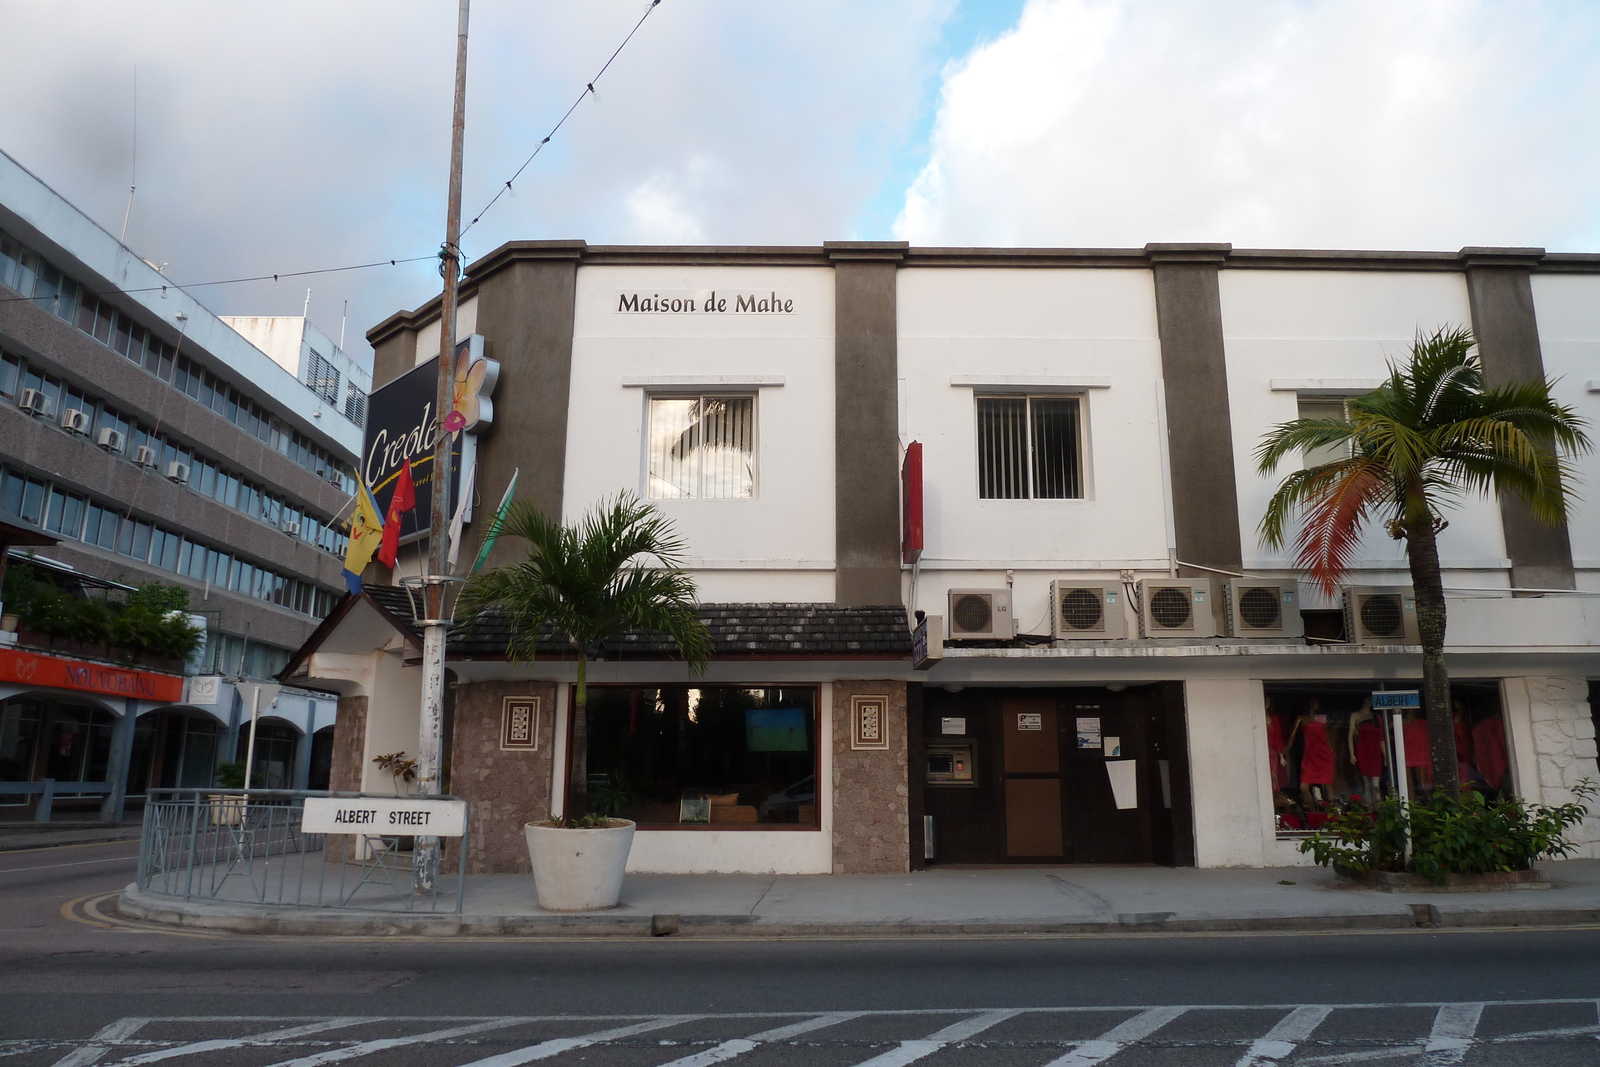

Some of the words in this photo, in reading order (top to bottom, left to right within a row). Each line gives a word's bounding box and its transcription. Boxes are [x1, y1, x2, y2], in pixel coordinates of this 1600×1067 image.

[618, 293, 696, 313] Maison
[704, 290, 728, 313] de
[735, 291, 794, 313] Mahe
[366, 401, 437, 487] Creole
[412, 473, 429, 487] ravel
[64, 665, 156, 697] NOUVOBANQ
[1376, 694, 1408, 707] ALBERT
[335, 809, 377, 824] ALBERT
[389, 811, 431, 826] STREET
